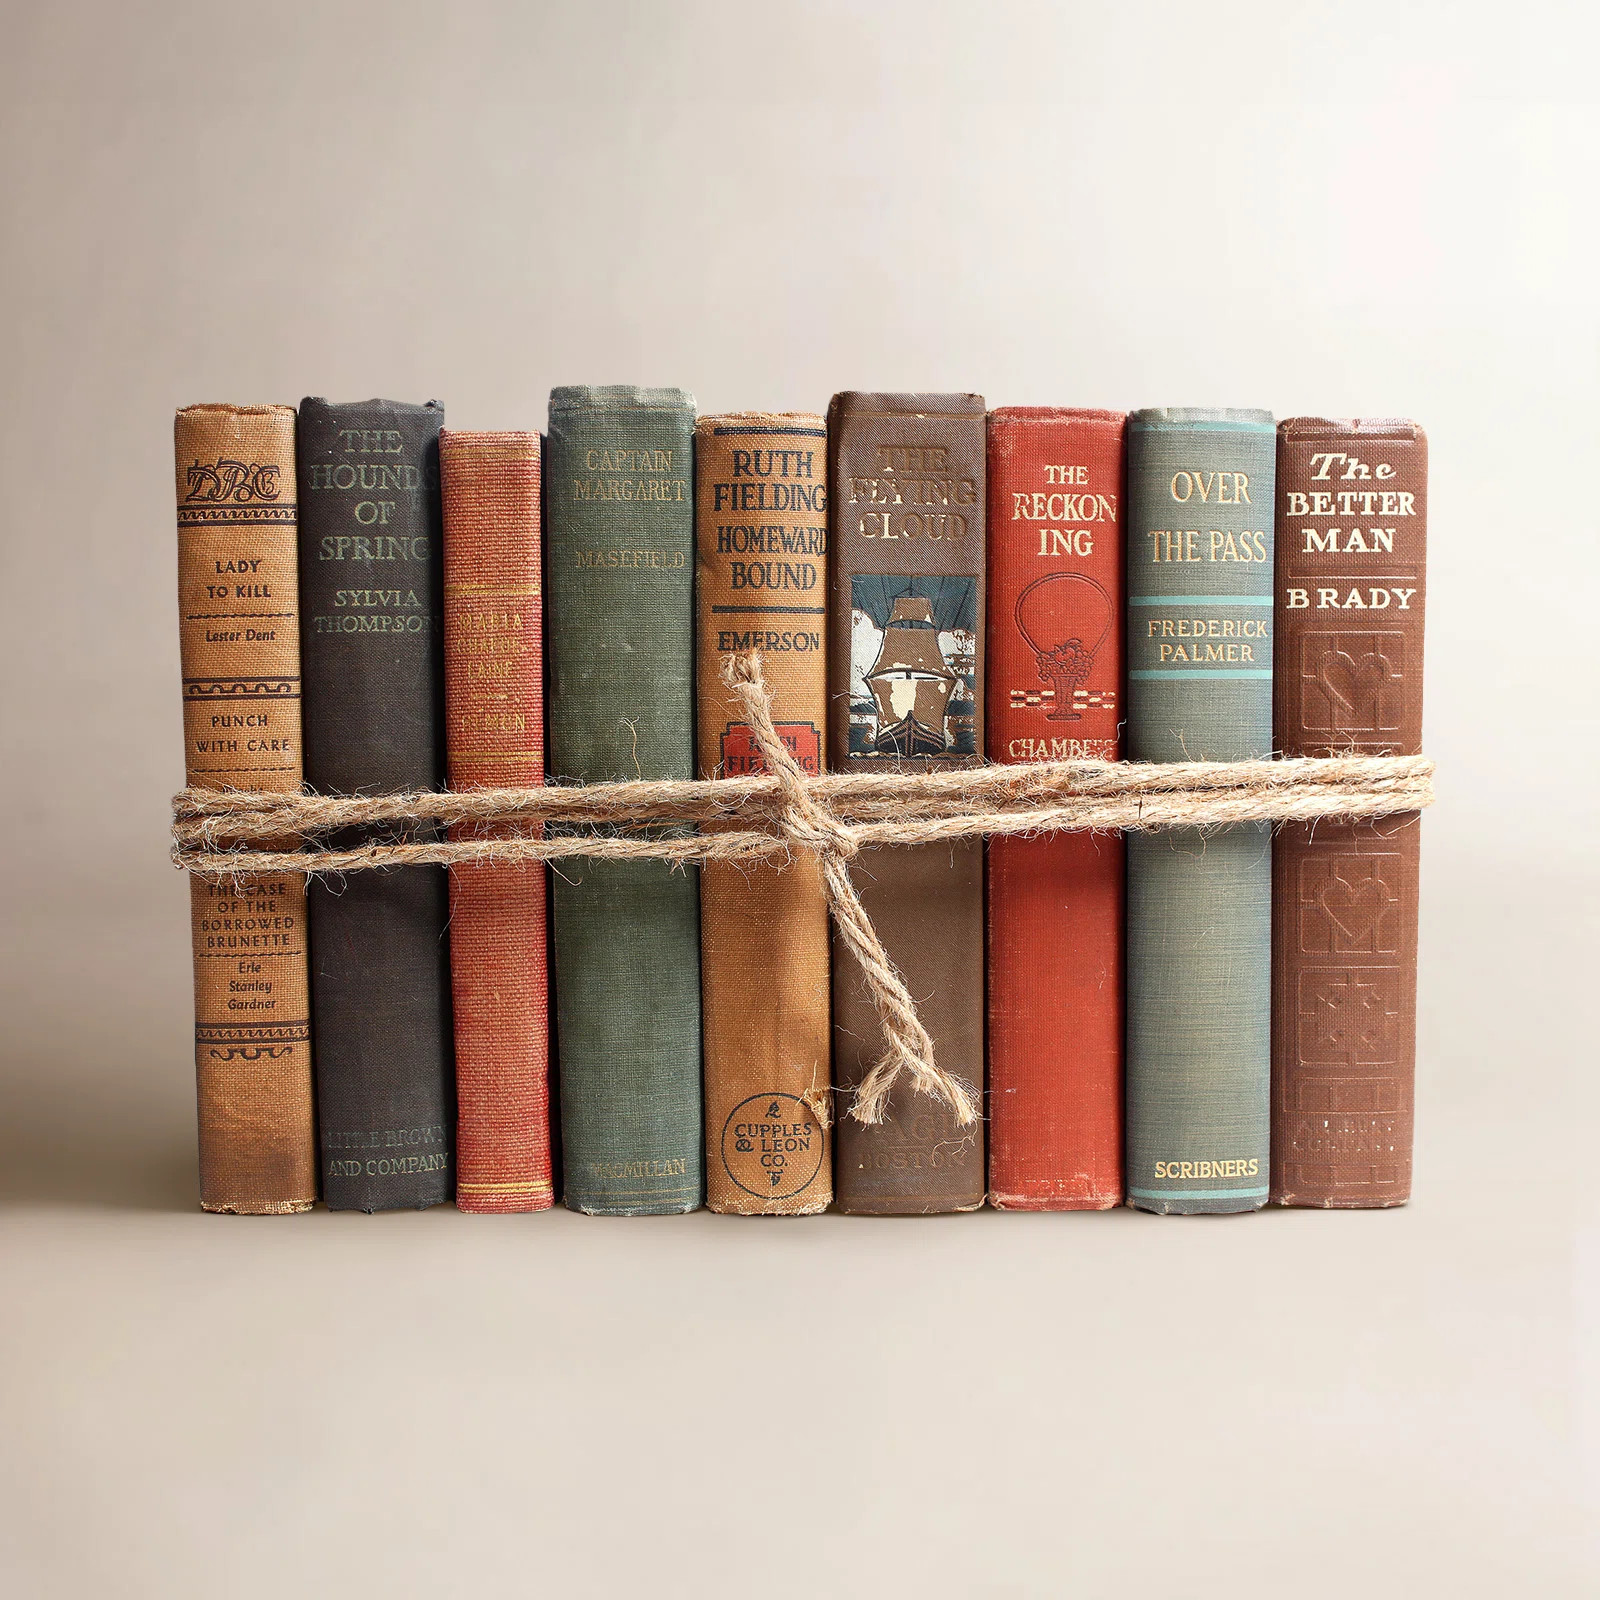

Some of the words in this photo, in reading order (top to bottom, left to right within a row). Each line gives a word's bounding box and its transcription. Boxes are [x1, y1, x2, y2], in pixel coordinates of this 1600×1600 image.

[339, 429, 402, 452] THE
[586, 450, 673, 472] CAPTAIN
[732, 449, 813, 478] RUTH
[878, 446, 948, 472] THE
[1310, 453, 1397, 481] The
[1043, 464, 1089, 485] THE
[573, 479, 686, 501] MARGARET
[713, 483, 827, 512] FIELDING
[848, 477, 976, 506] FLYING
[1171, 471, 1252, 504] OVER
[354, 501, 395, 524] OF
[1011, 493, 1117, 522] RECKON
[1286, 492, 1416, 517] BETTER
[859, 512, 968, 541] CLOUD
[319, 536, 431, 561] SPRING
[716, 525, 828, 556] HOMEWARD
[1037, 529, 1094, 557] ING
[1148, 530, 1200, 563] THE
[1209, 530, 1267, 563] PASS
[1302, 528, 1396, 553] MAN
[215, 559, 262, 574] LADY
[576, 551, 686, 568] MASEFIELD
[729, 561, 817, 591] BOUND
[207, 585, 229, 599] TO
[236, 584, 271, 598] KILL
[334, 589, 422, 607] SYLVIA
[1286, 588, 1416, 609] BRADY
[205, 629, 241, 642] Lester
[245, 629, 276, 641] Dent
[1148, 619, 1269, 638] FREDERICK
[717, 631, 820, 652] EMERSON
[1159, 643, 1255, 662] PALMER
[211, 715, 268, 728] PUNCH
[196, 740, 237, 753] WITH
[246, 739, 290, 752] CARE
[207, 884, 237, 897] THE
[245, 883, 286, 896] CASE
[217, 901, 238, 913] OF
[246, 900, 276, 912] THE
[201, 917, 294, 932] BORROWED
[207, 933, 290, 948] BRUNETTE
[238, 961, 261, 974] Erle
[229, 980, 272, 994] Stanley
[227, 998, 276, 1010] Gardner
[734, 1122, 812, 1138] CUPPLES
[760, 1137, 811, 1153] LEON
[328, 1160, 362, 1177] AND
[366, 1152, 448, 1176] COMPANY
[592, 1157, 686, 1179] MACMILLAN
[760, 1154, 789, 1168] CO.
[1154, 1158, 1259, 1179] SCRIBNERS
